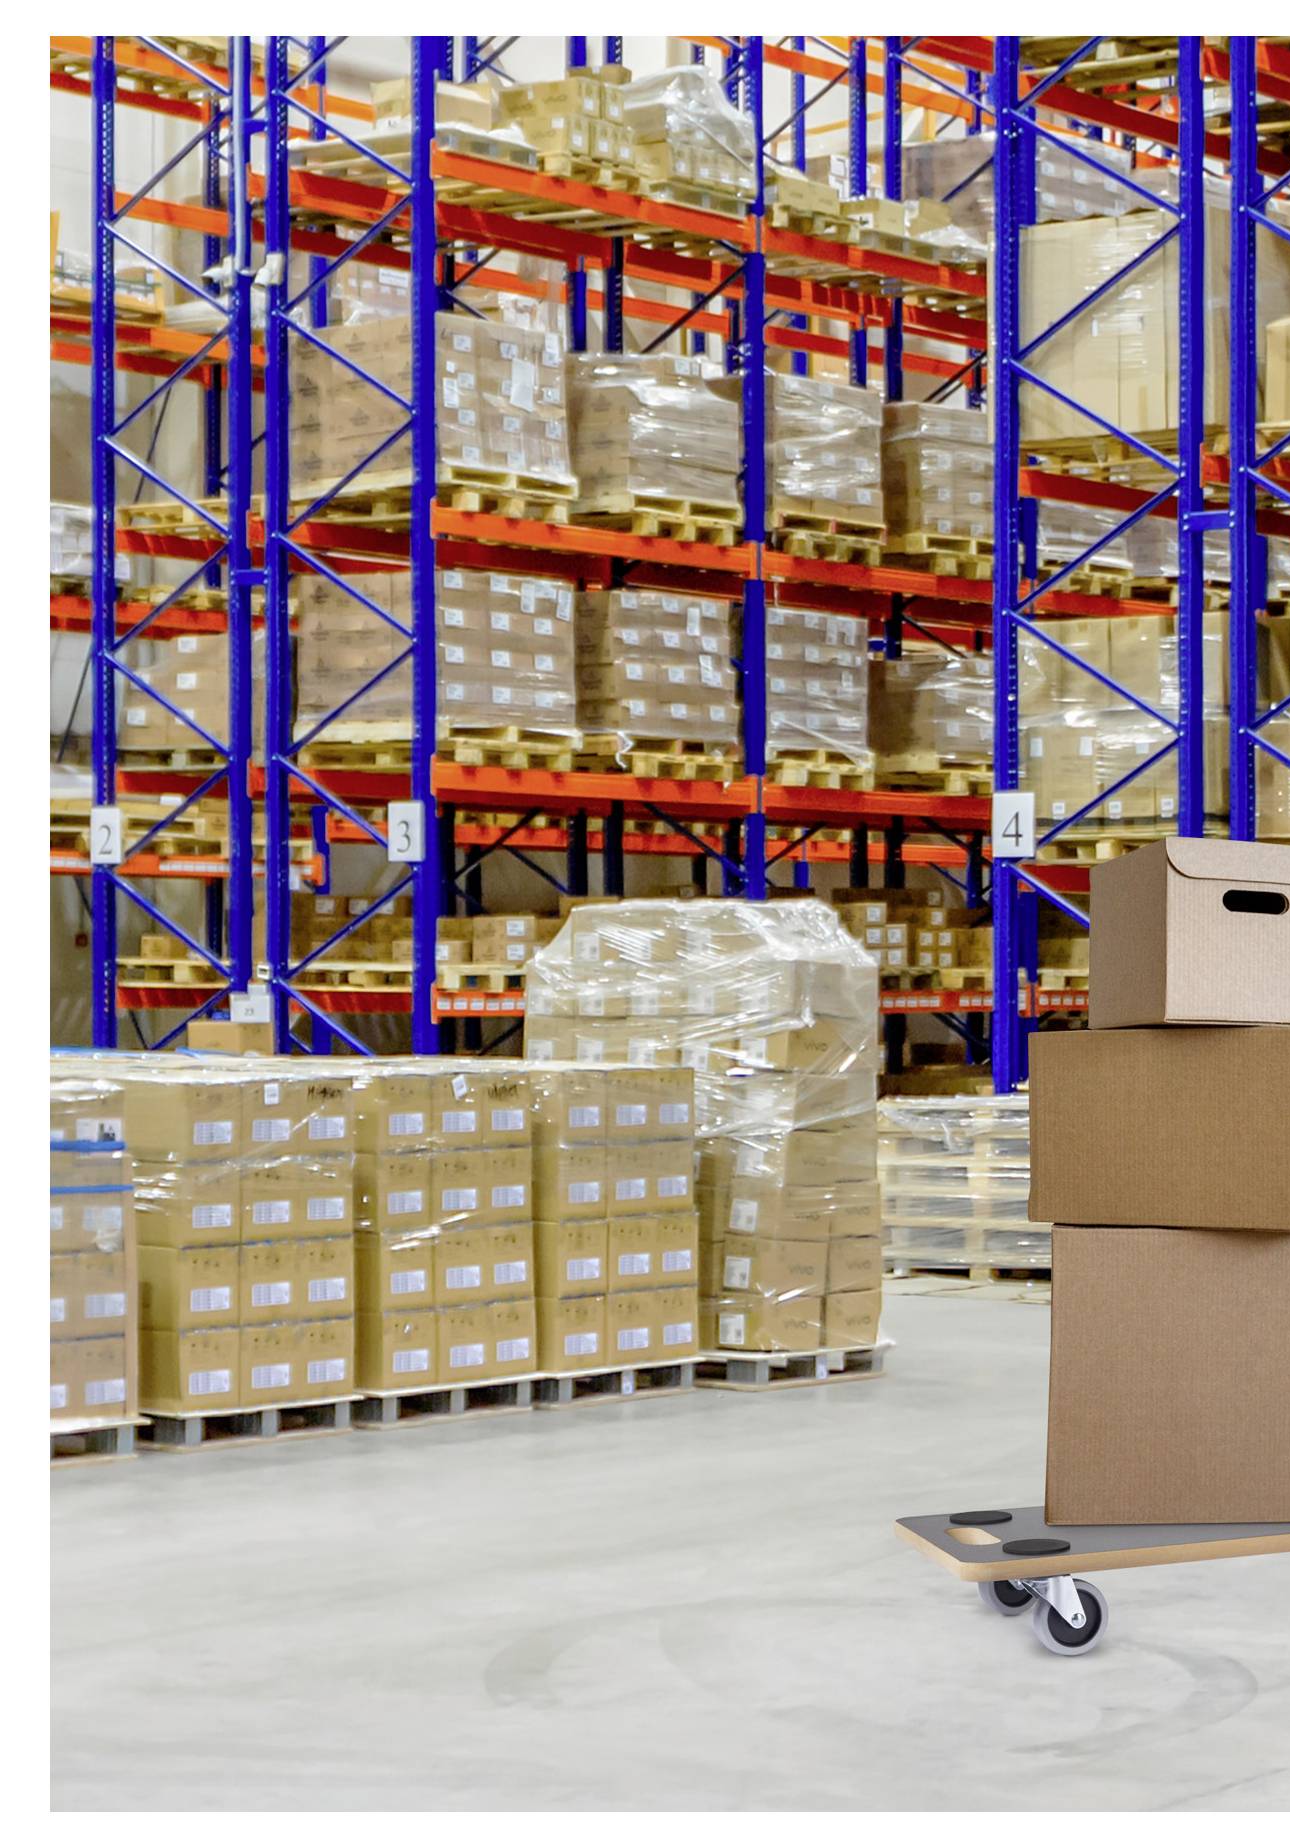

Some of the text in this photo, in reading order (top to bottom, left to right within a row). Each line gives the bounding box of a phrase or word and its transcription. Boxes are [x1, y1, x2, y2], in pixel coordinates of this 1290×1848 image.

[98, 824, 113, 855] 2
[397, 820, 412, 853] 3
[1002, 811, 1023, 848] 4
